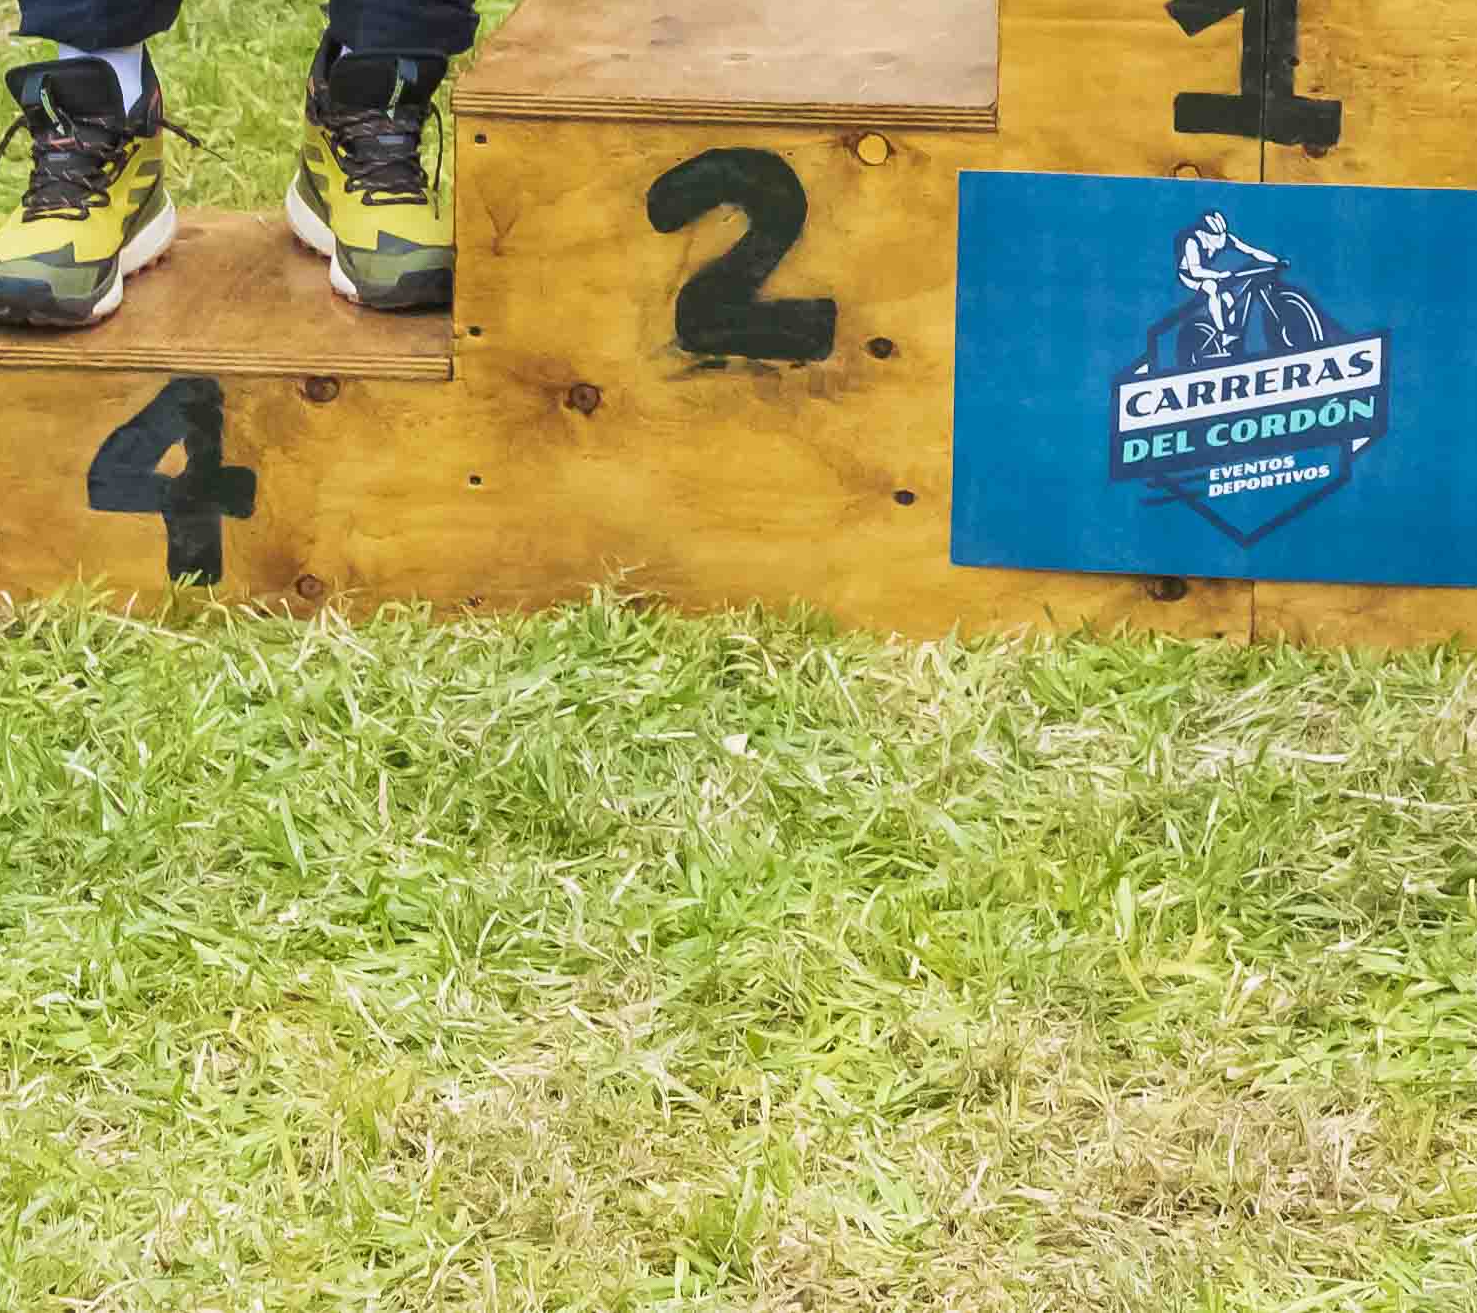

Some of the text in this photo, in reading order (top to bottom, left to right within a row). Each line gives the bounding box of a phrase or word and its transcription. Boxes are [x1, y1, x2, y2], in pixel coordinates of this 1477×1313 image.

[646, 147, 837, 362] 2
[1125, 349, 1374, 418] CARRERAS
[1123, 396, 1375, 463] DEL CORDÓN
[87, 377, 257, 587] 4
[1208, 465, 1331, 497] DEPORTIVOS
[1209, 455, 1296, 481] EVENTOS
